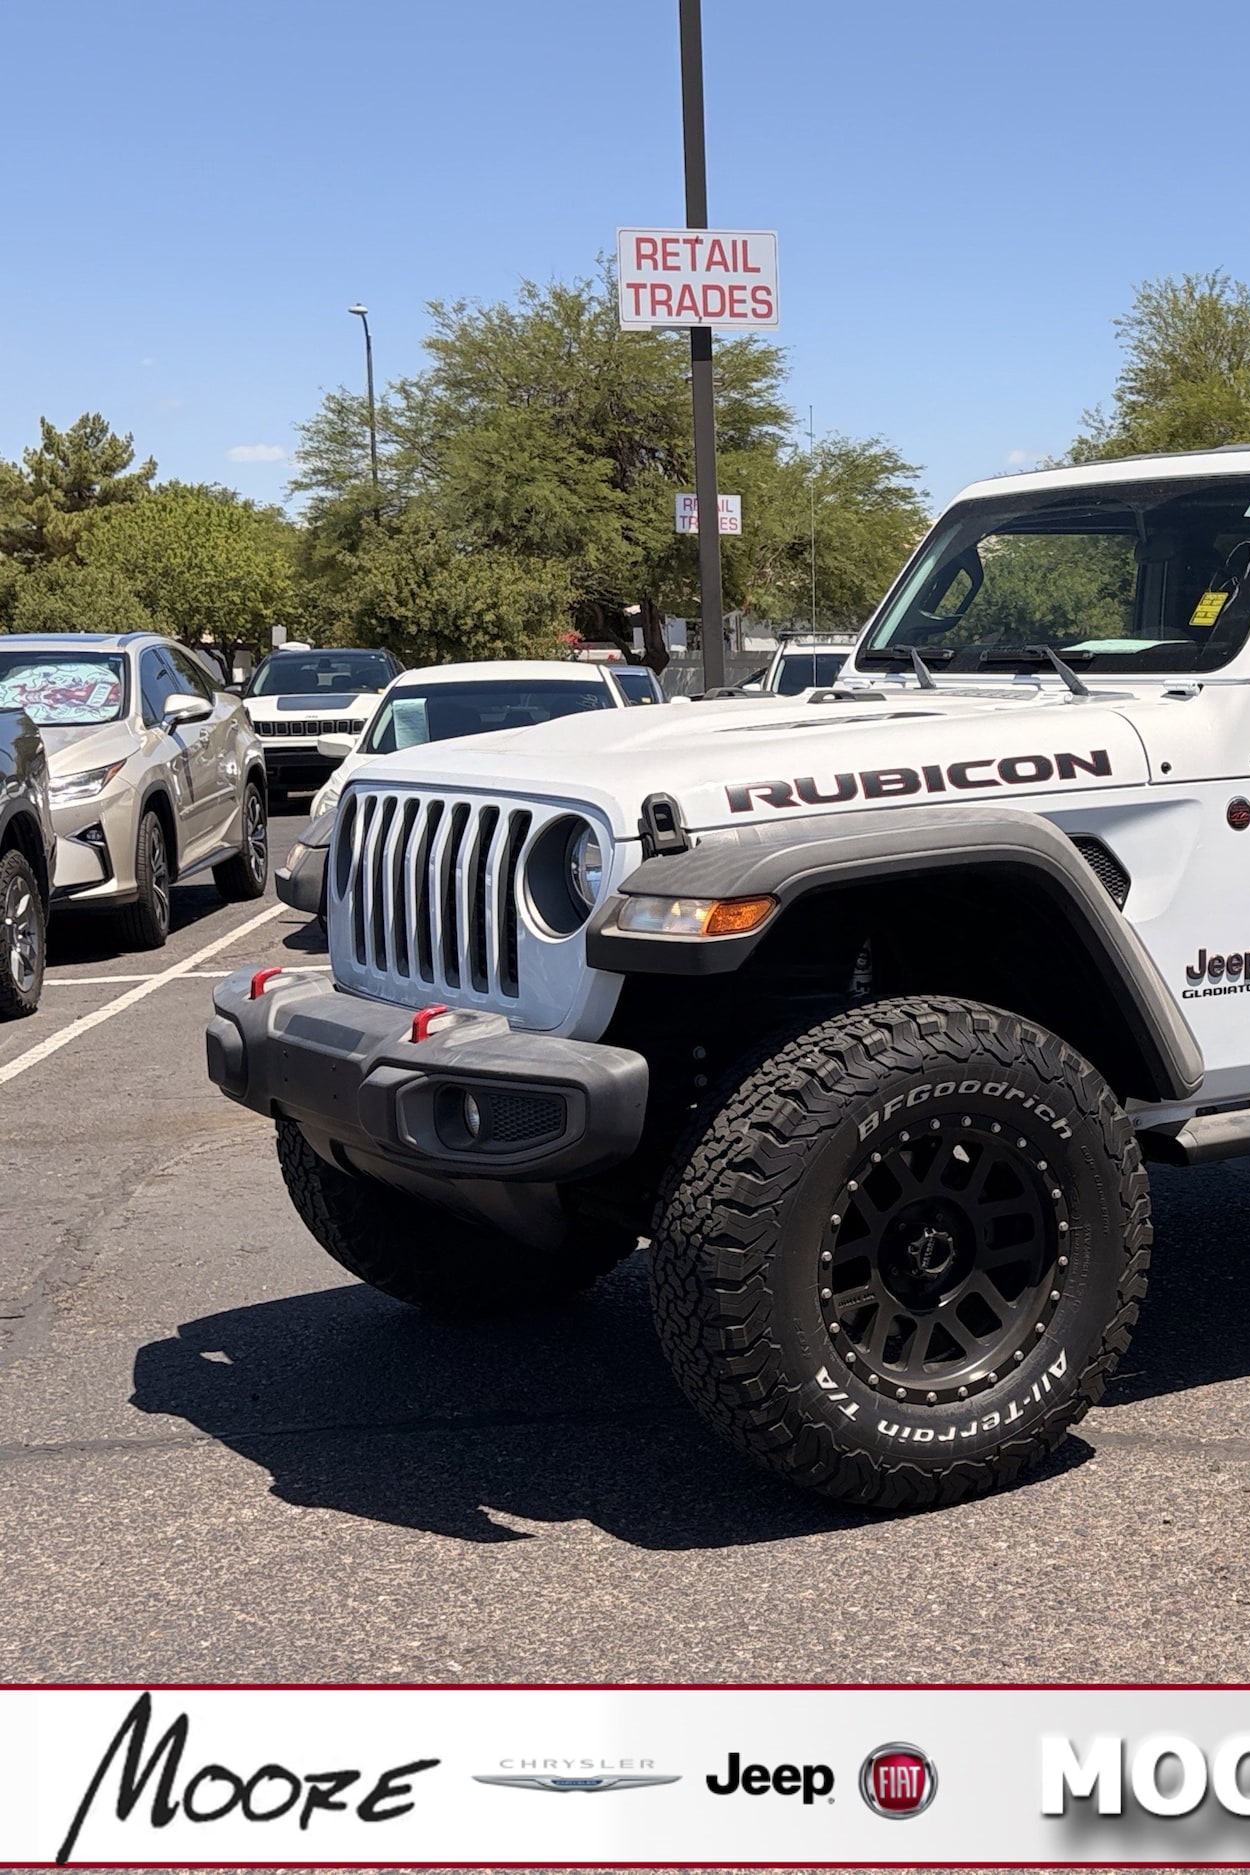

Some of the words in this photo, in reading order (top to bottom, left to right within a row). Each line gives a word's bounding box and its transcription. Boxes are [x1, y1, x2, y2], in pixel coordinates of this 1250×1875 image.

[634, 236, 762, 274] RETAIL
[626, 282, 774, 319] TRADES
[679, 515, 738, 531] TRES
[683, 497, 734, 513] RIL
[724, 749, 1113, 814] RUBICON
[858, 1079, 1074, 1143] BFGoodrich
[815, 1365, 861, 1423] T/A
[876, 1347, 1069, 1444] All-Terrain
